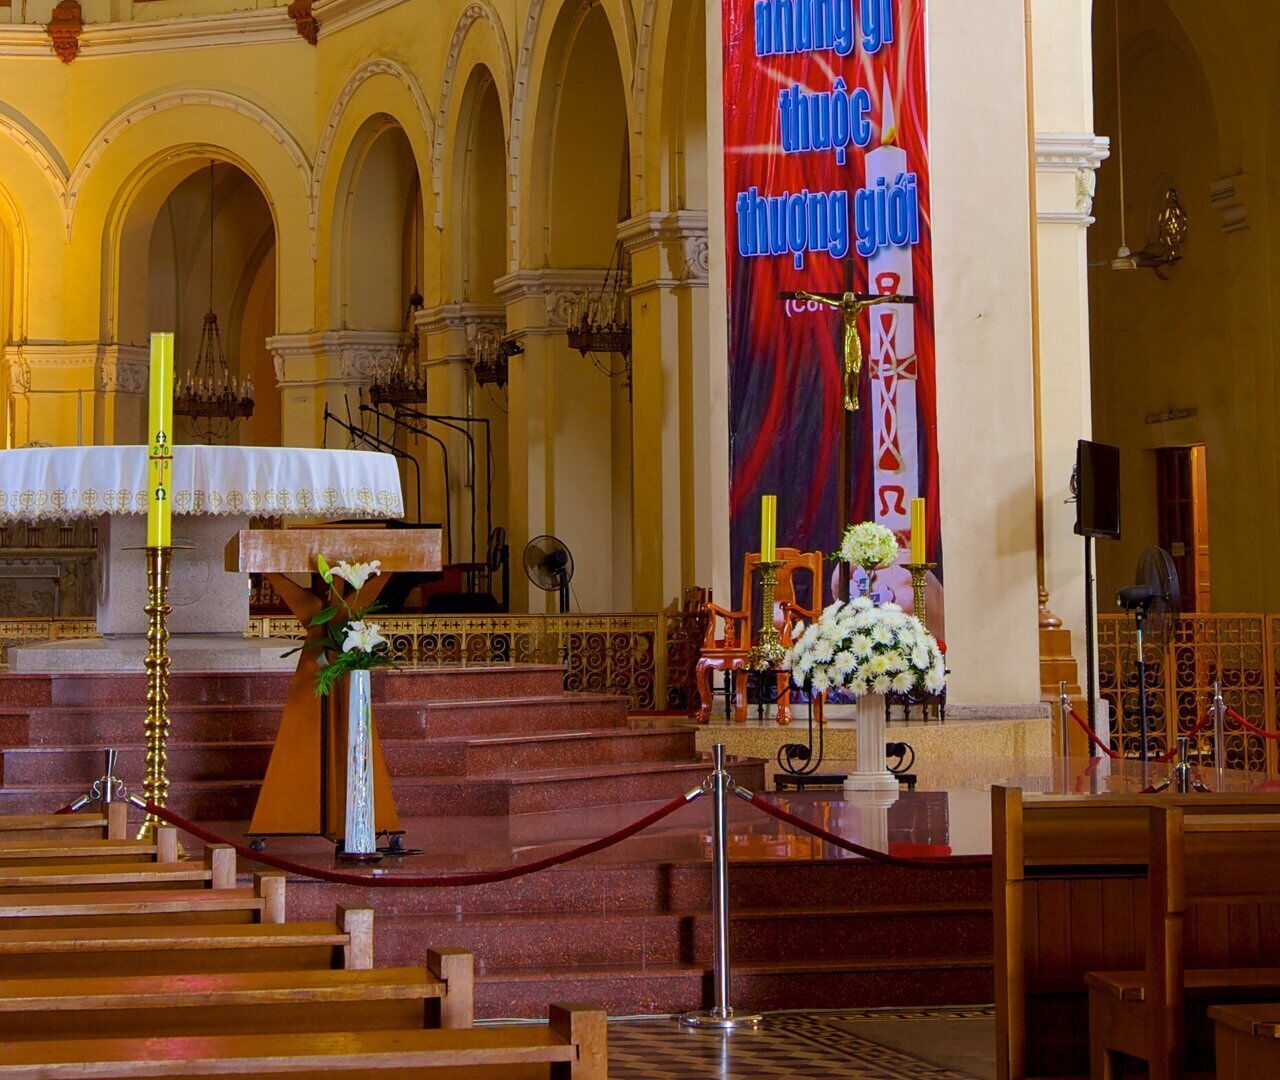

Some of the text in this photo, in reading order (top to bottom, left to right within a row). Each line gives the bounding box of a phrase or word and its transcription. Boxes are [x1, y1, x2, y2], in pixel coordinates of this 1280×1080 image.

[778, 75, 872, 165] thuộc
[736, 172, 920, 270] thượng giới
